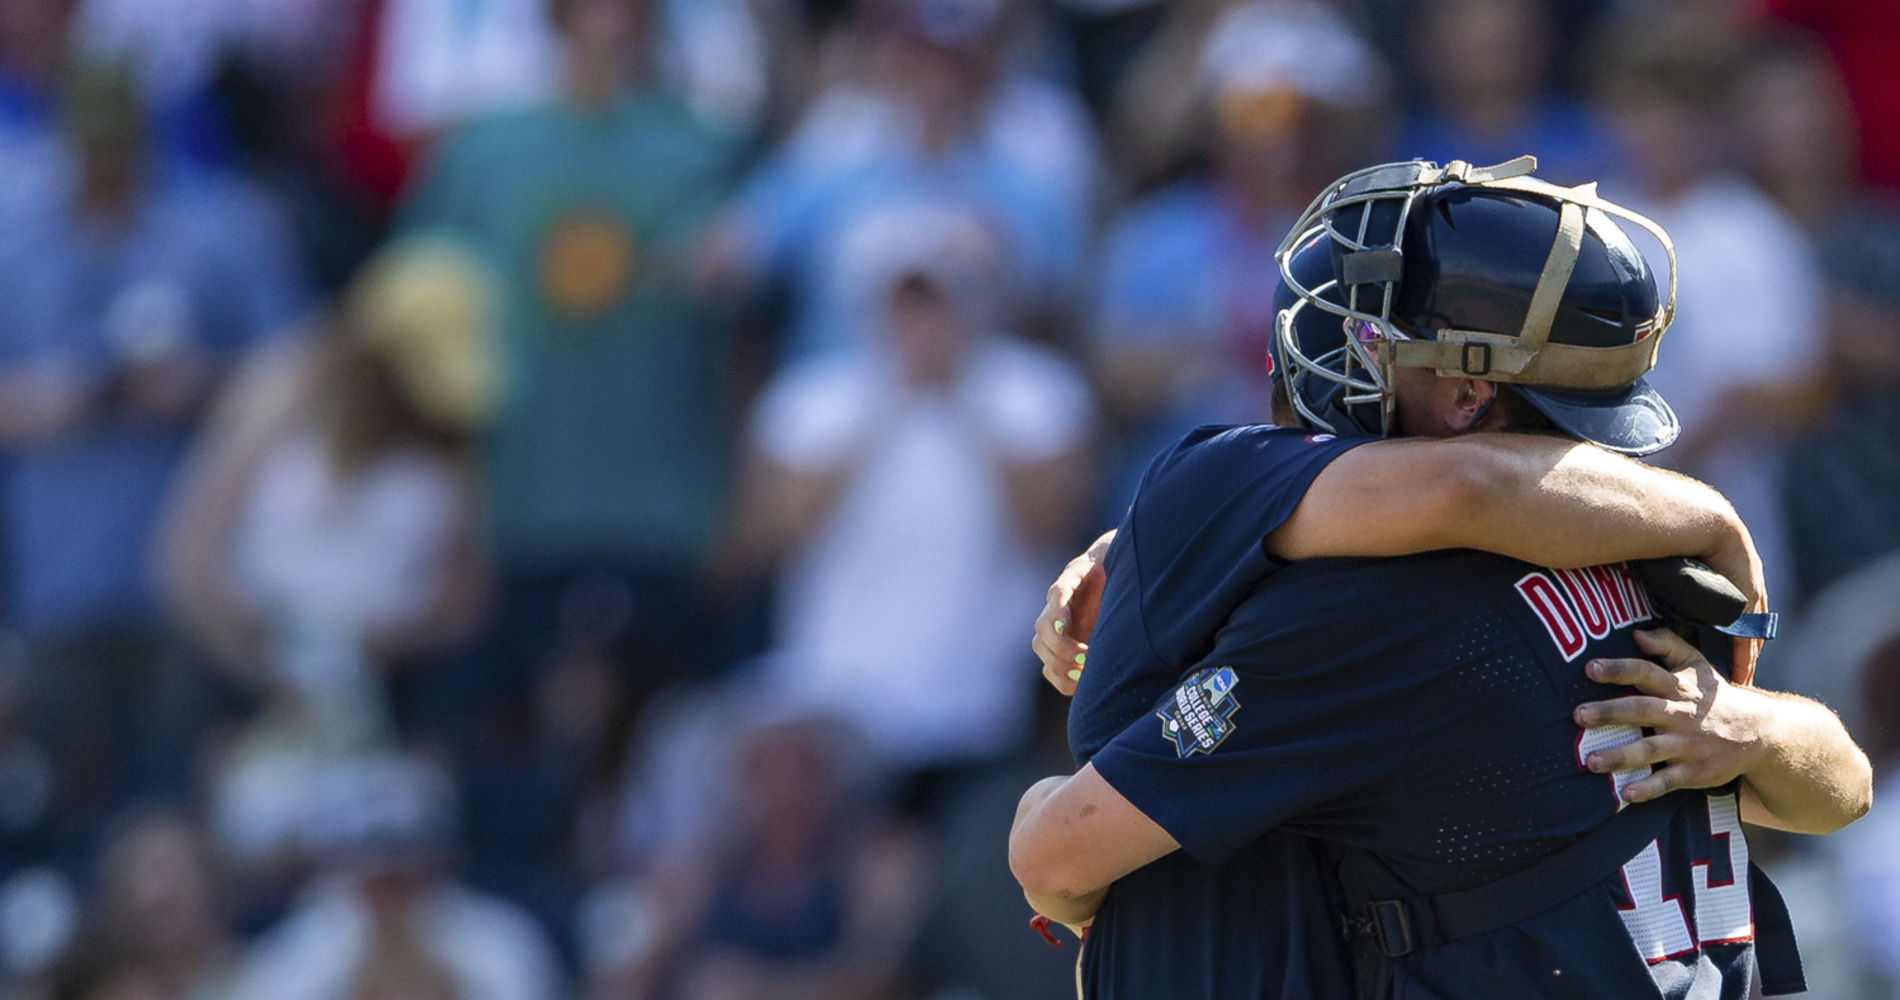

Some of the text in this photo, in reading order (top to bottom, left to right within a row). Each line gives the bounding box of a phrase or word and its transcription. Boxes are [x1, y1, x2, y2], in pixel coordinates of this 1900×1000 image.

[1514, 559, 1660, 663] DUNH
[1176, 686, 1215, 749] WORLD SERIES
[1186, 686, 1213, 726] COLLEGE
